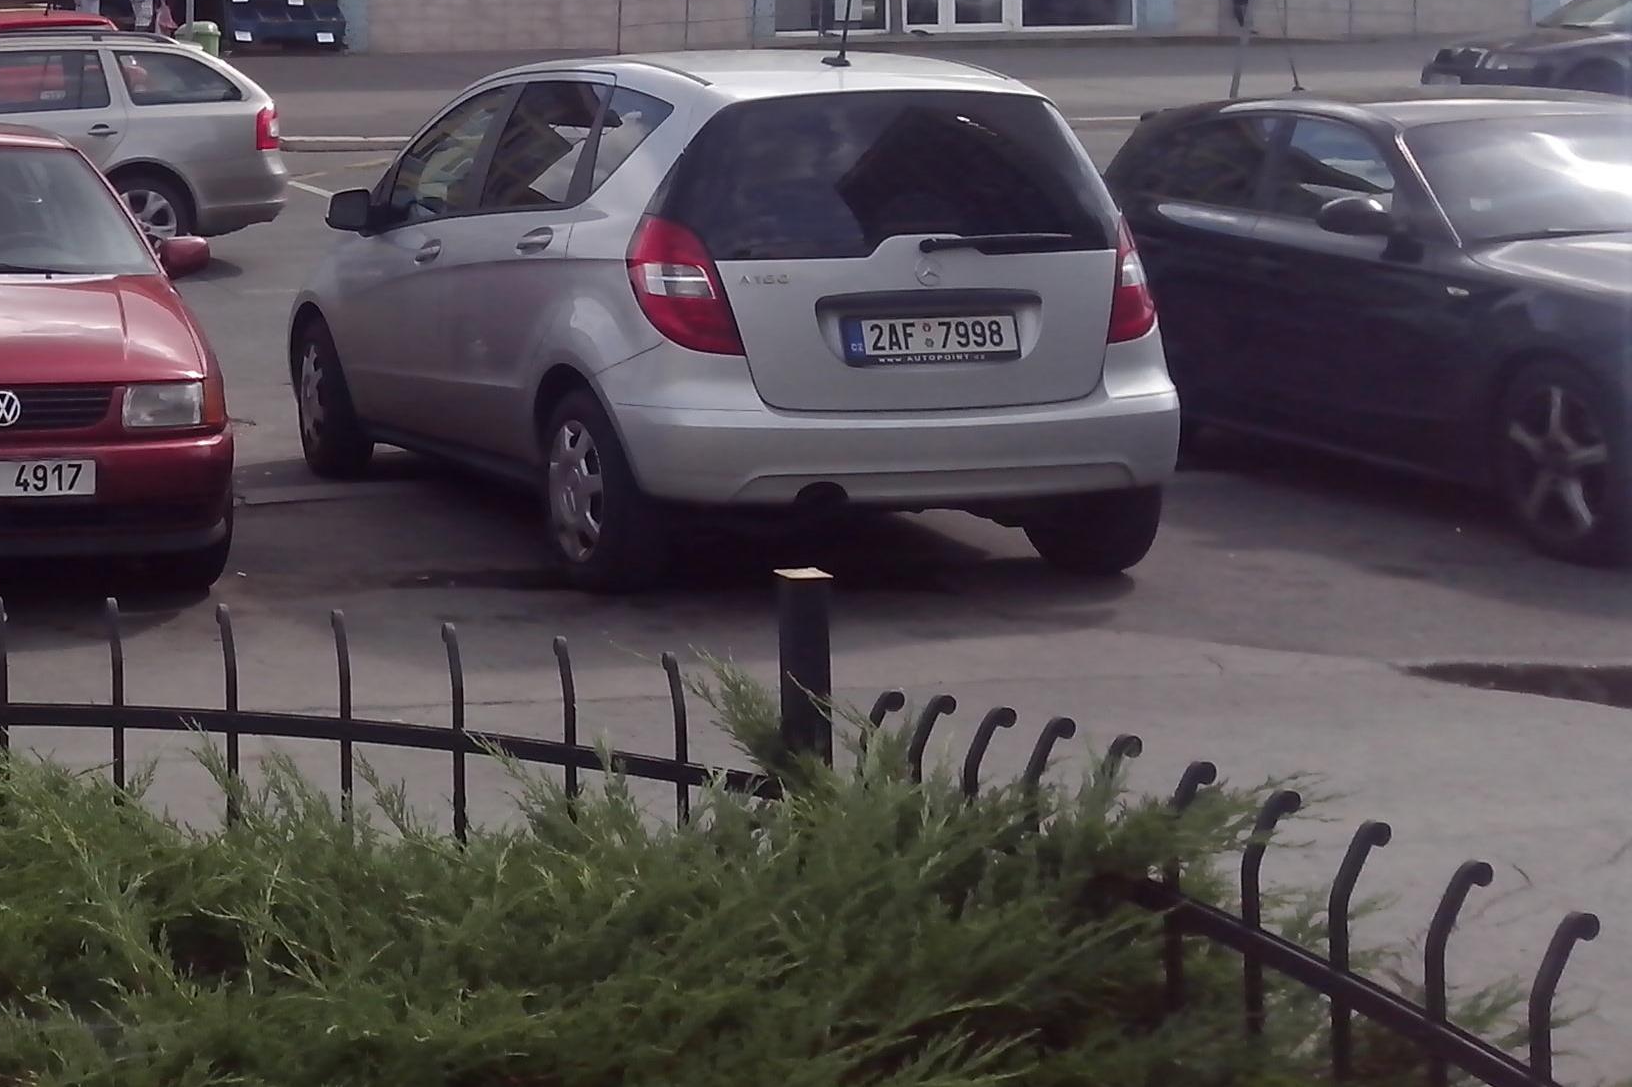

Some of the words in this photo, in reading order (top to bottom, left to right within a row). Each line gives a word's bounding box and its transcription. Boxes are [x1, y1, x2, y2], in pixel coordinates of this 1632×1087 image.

[851, 343, 864, 352] CZ
[870, 322, 916, 351] 2AF
[937, 320, 1004, 349] 7998
[15, 463, 83, 492] 4917
